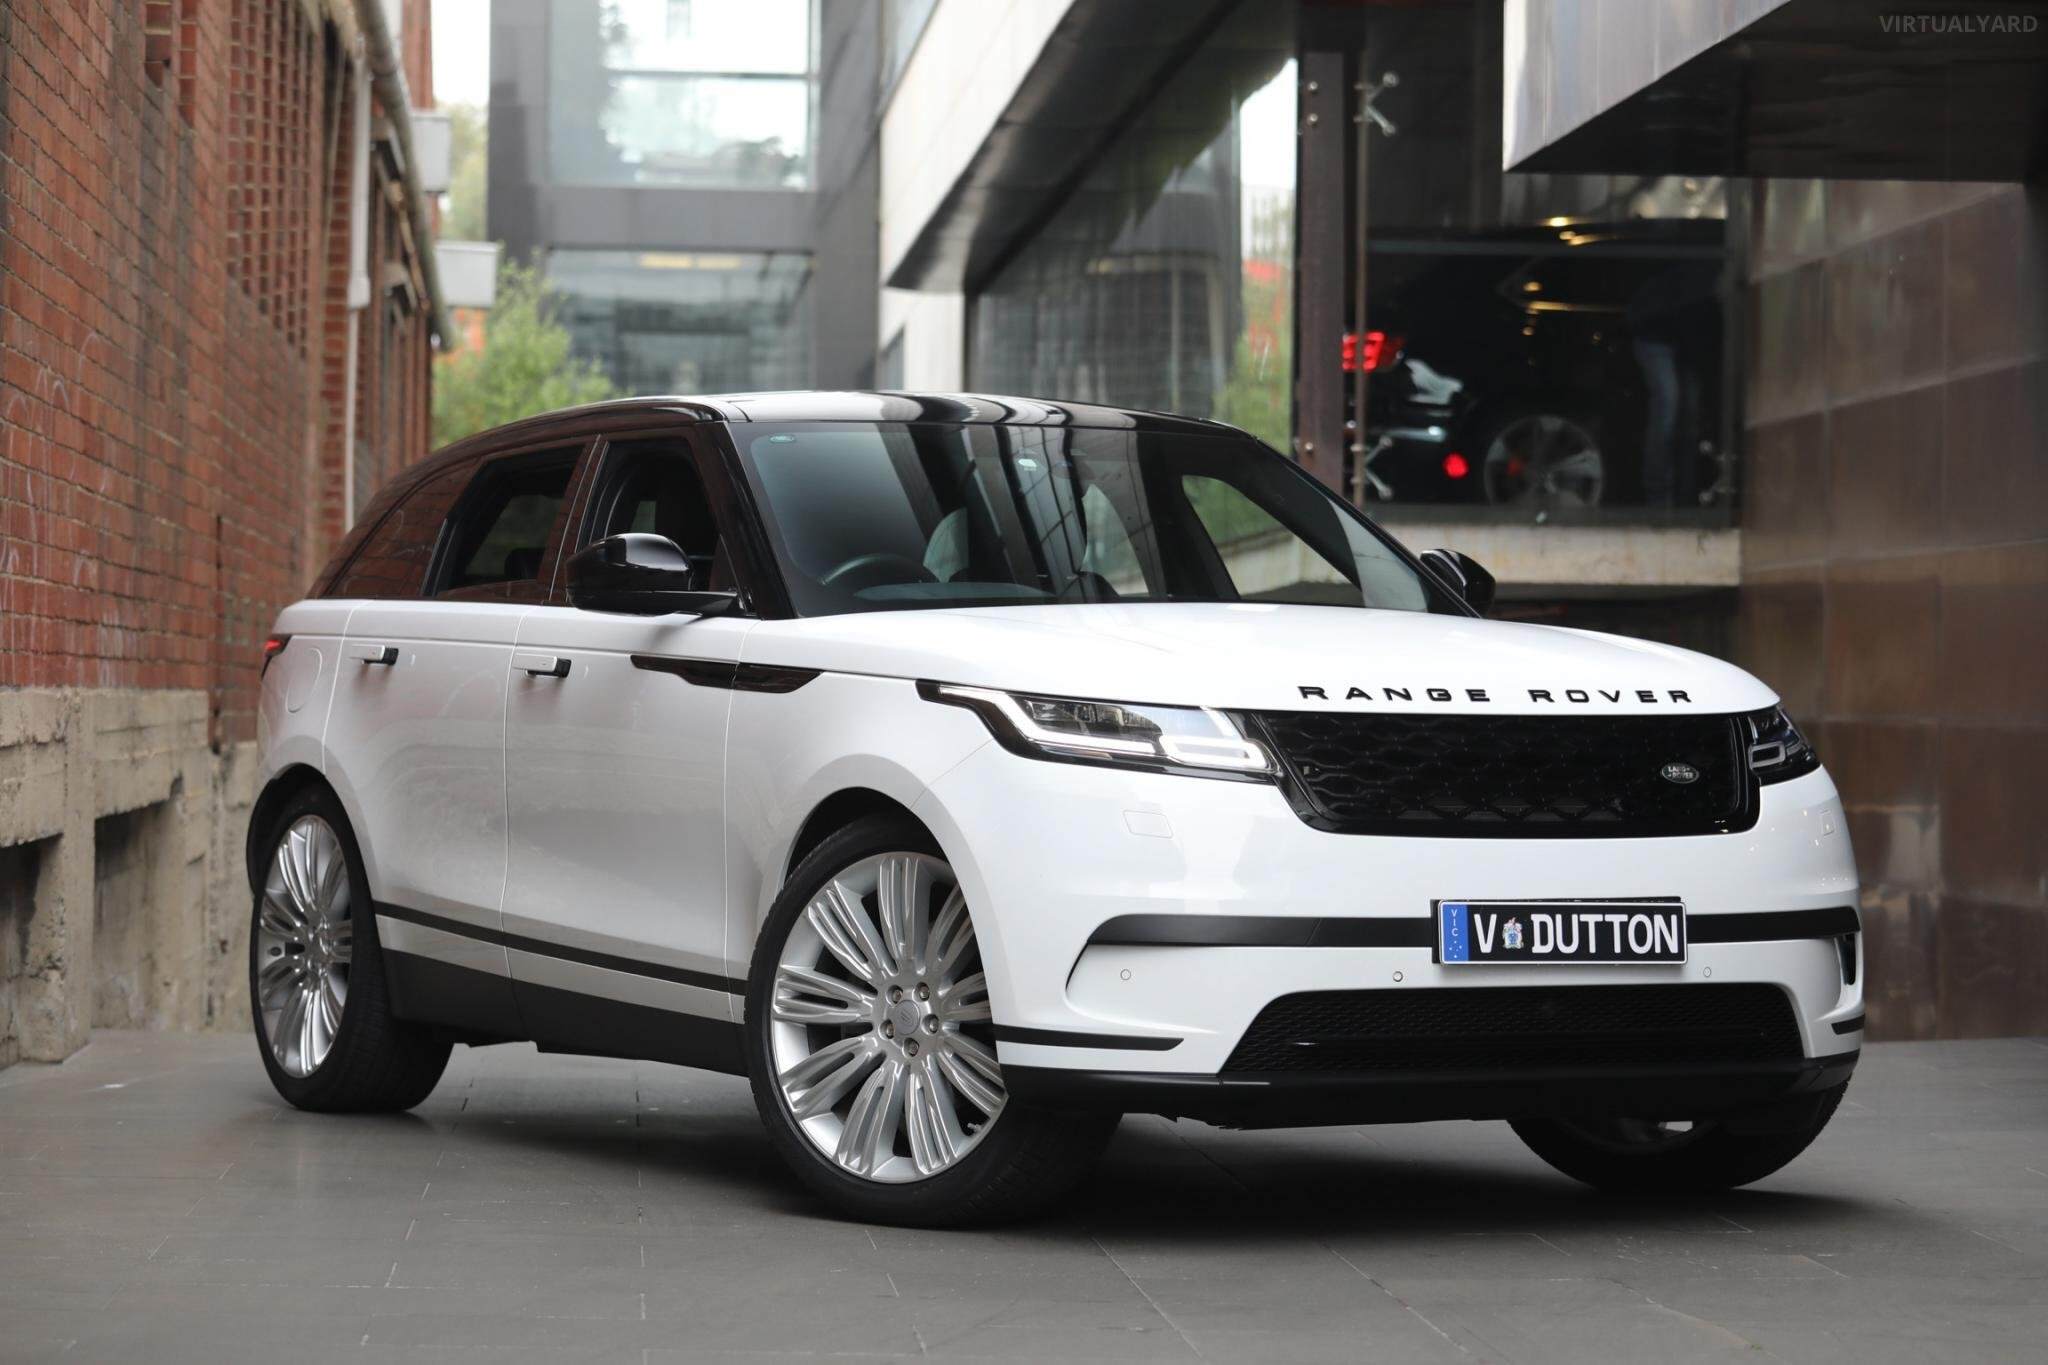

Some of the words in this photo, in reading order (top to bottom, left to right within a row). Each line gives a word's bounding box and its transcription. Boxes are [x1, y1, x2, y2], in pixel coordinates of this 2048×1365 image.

[1297, 686, 1491, 702] RANGE
[1527, 689, 1692, 703] ROVER
[1450, 908, 1459, 937] VIC
[1473, 913, 1497, 954] V
[1530, 913, 1679, 954] DUTTON
